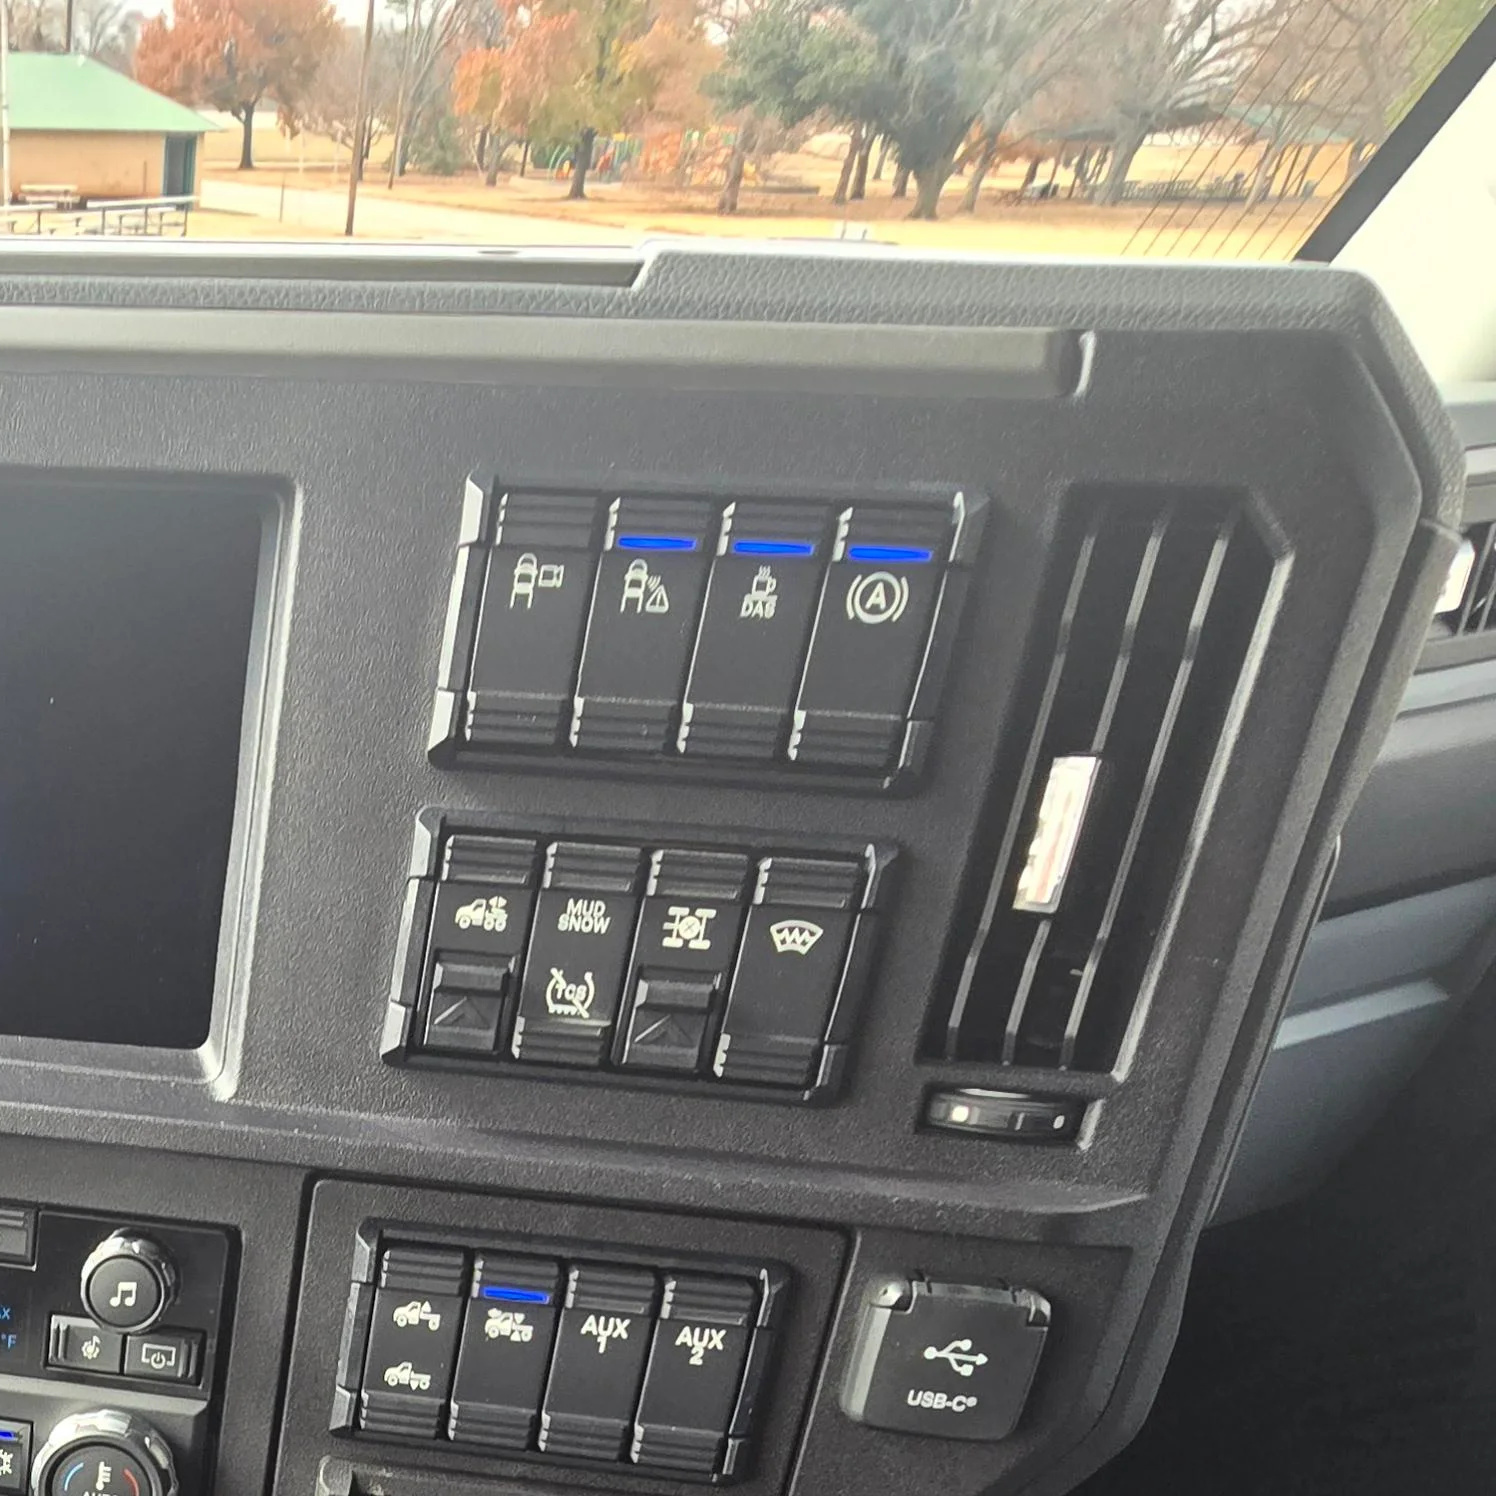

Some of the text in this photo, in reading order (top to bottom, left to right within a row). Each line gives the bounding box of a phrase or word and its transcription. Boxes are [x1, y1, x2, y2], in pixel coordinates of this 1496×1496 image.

[566, 898, 606, 917] MUD
[558, 913, 611, 934] SNOW
[580, 1314, 631, 1339] AUX
[596, 1336, 607, 1354] 1
[675, 1325, 727, 1350] AUX
[689, 1346, 705, 1366] 2
